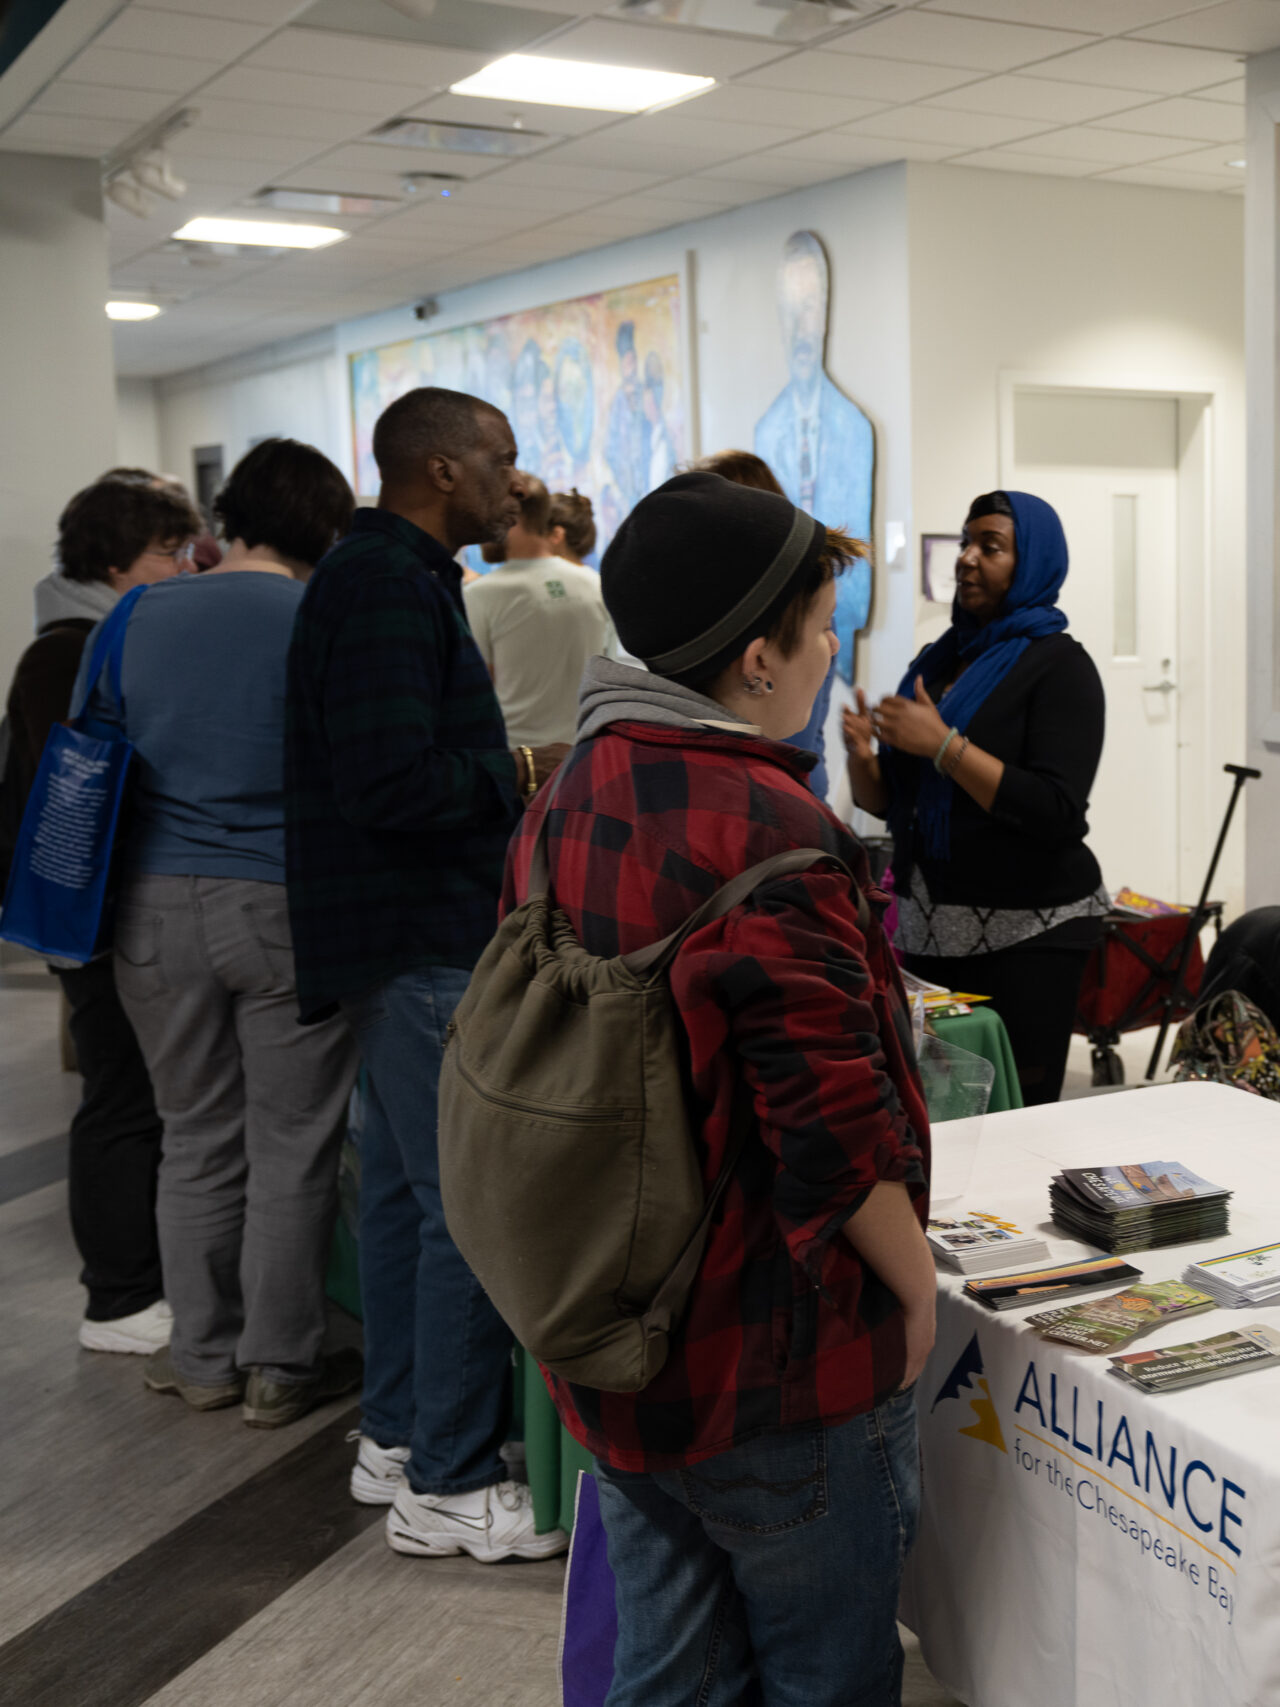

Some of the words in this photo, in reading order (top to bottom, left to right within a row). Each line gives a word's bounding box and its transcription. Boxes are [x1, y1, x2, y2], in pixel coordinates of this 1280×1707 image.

[1143, 1361, 1180, 1373] Reduce
[1180, 1356, 1203, 1368] your
[1014, 1361, 1246, 1558] ALLIANCE
[1014, 1438, 1041, 1476] for
[1046, 1459, 1074, 1497] the
[1077, 1479, 1200, 1585] Chesapeake
